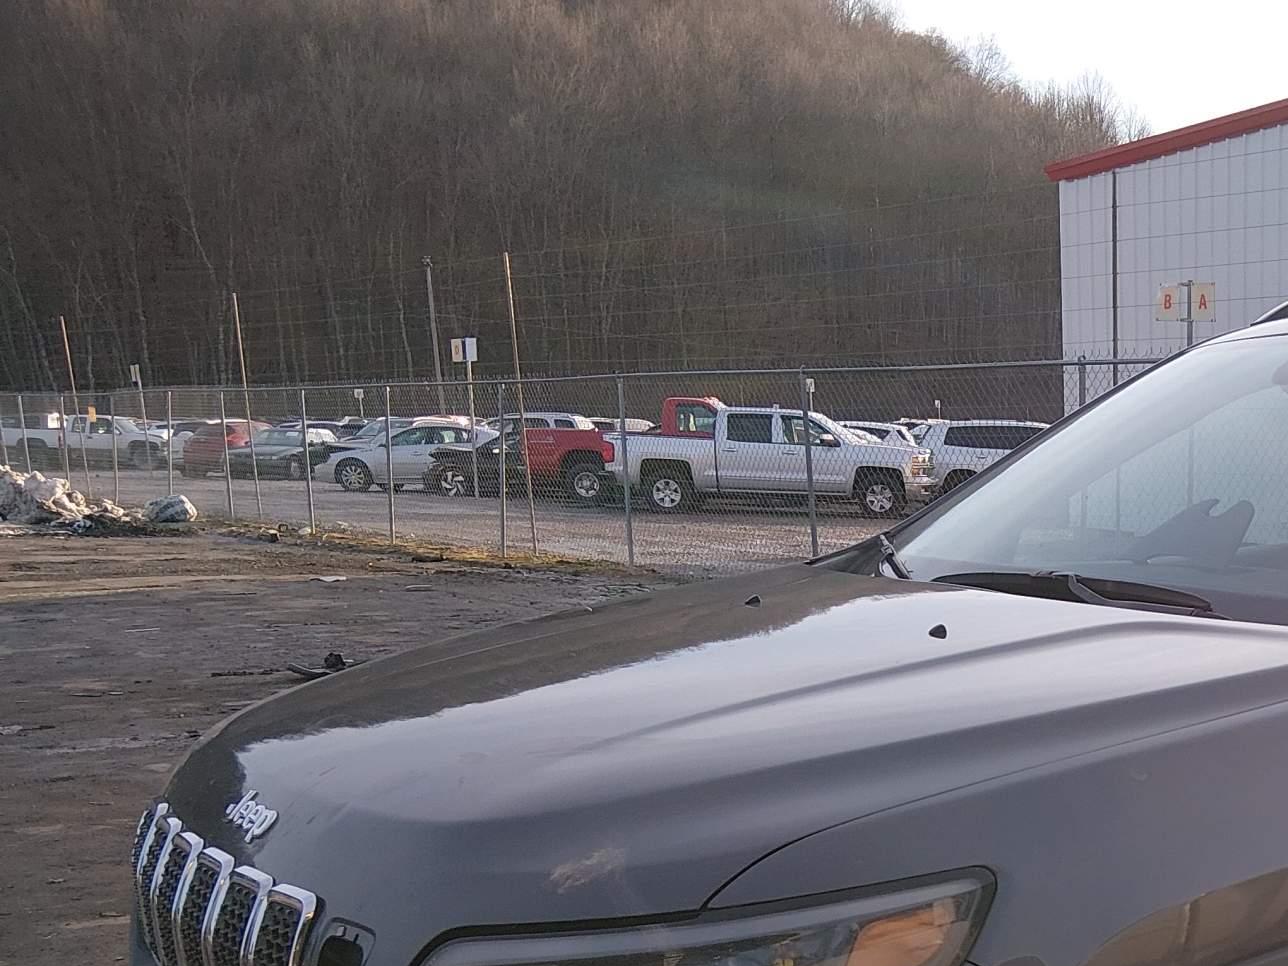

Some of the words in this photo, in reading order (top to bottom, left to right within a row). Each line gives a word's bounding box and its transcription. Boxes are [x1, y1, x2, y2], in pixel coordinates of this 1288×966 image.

[1163, 293, 1172, 310] B
[1198, 293, 1208, 310] A
[225, 789, 278, 843] Jeep
